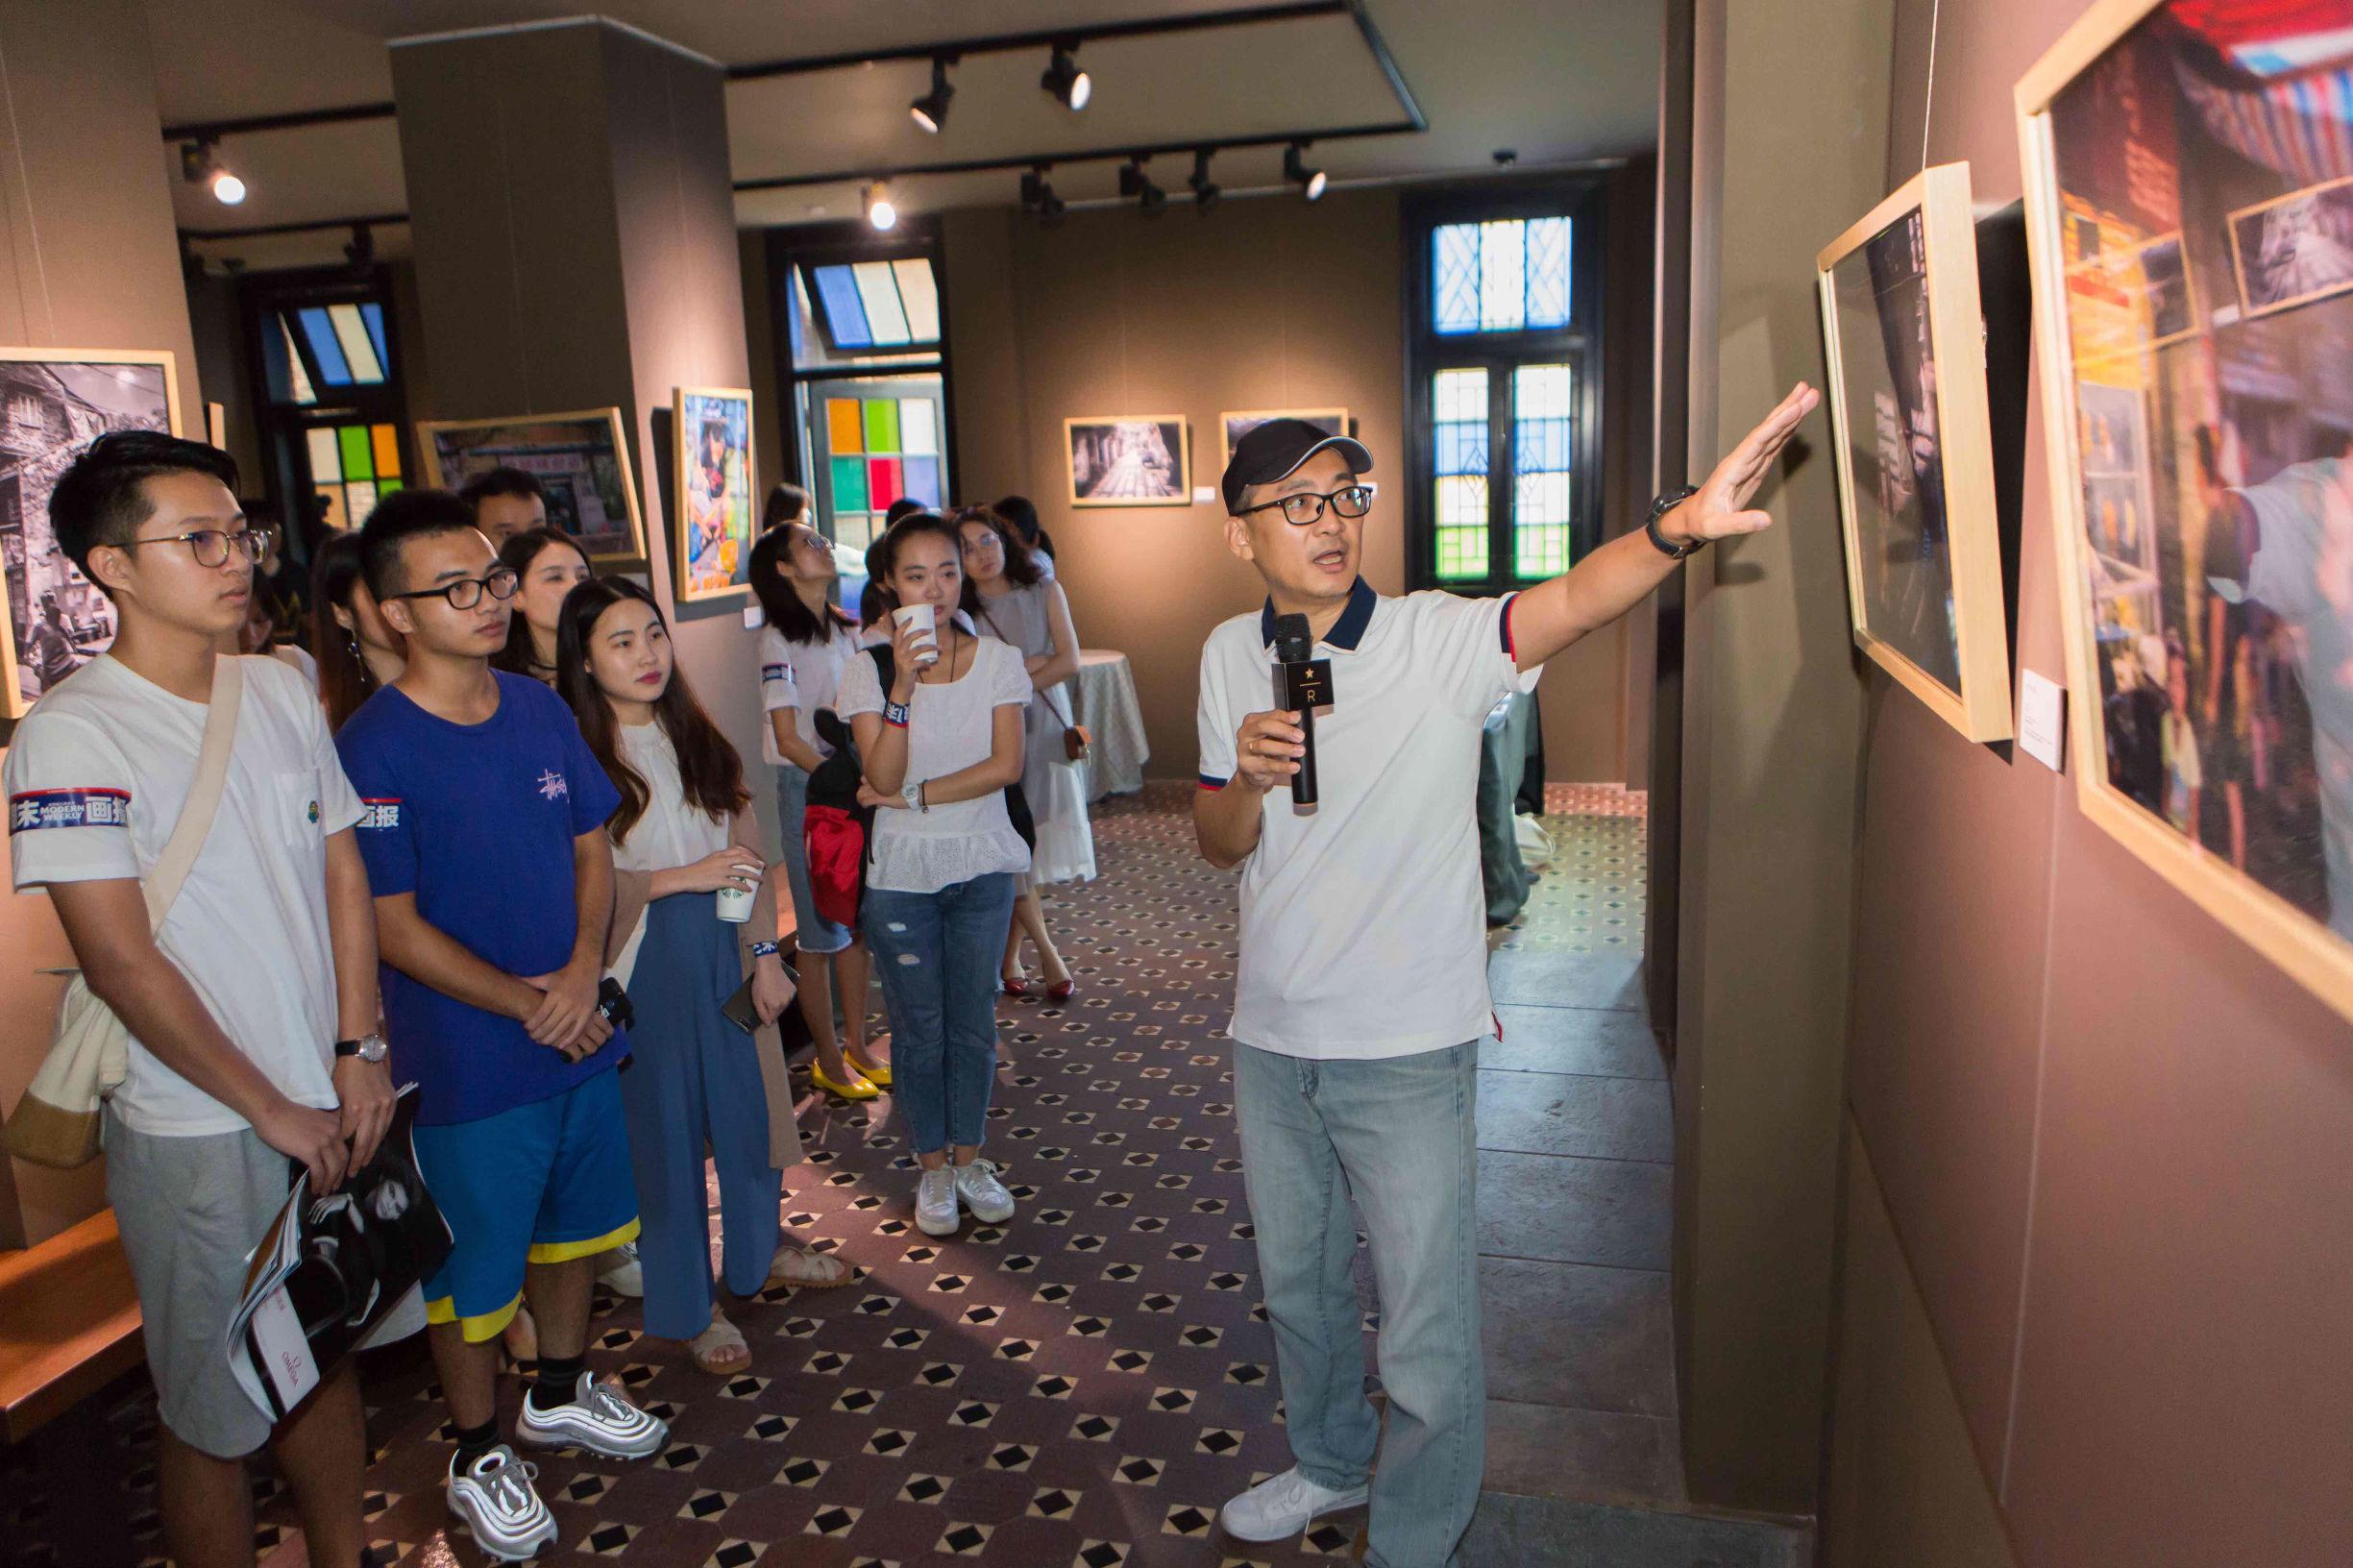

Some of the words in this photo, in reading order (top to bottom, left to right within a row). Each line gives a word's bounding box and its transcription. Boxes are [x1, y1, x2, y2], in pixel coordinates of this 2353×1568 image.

[1307, 689, 1316, 702] R
[39, 804, 86, 816] MODERN
[44, 812, 83, 821] WEEKLY
[282, 1351, 299, 1387] OMEGA
